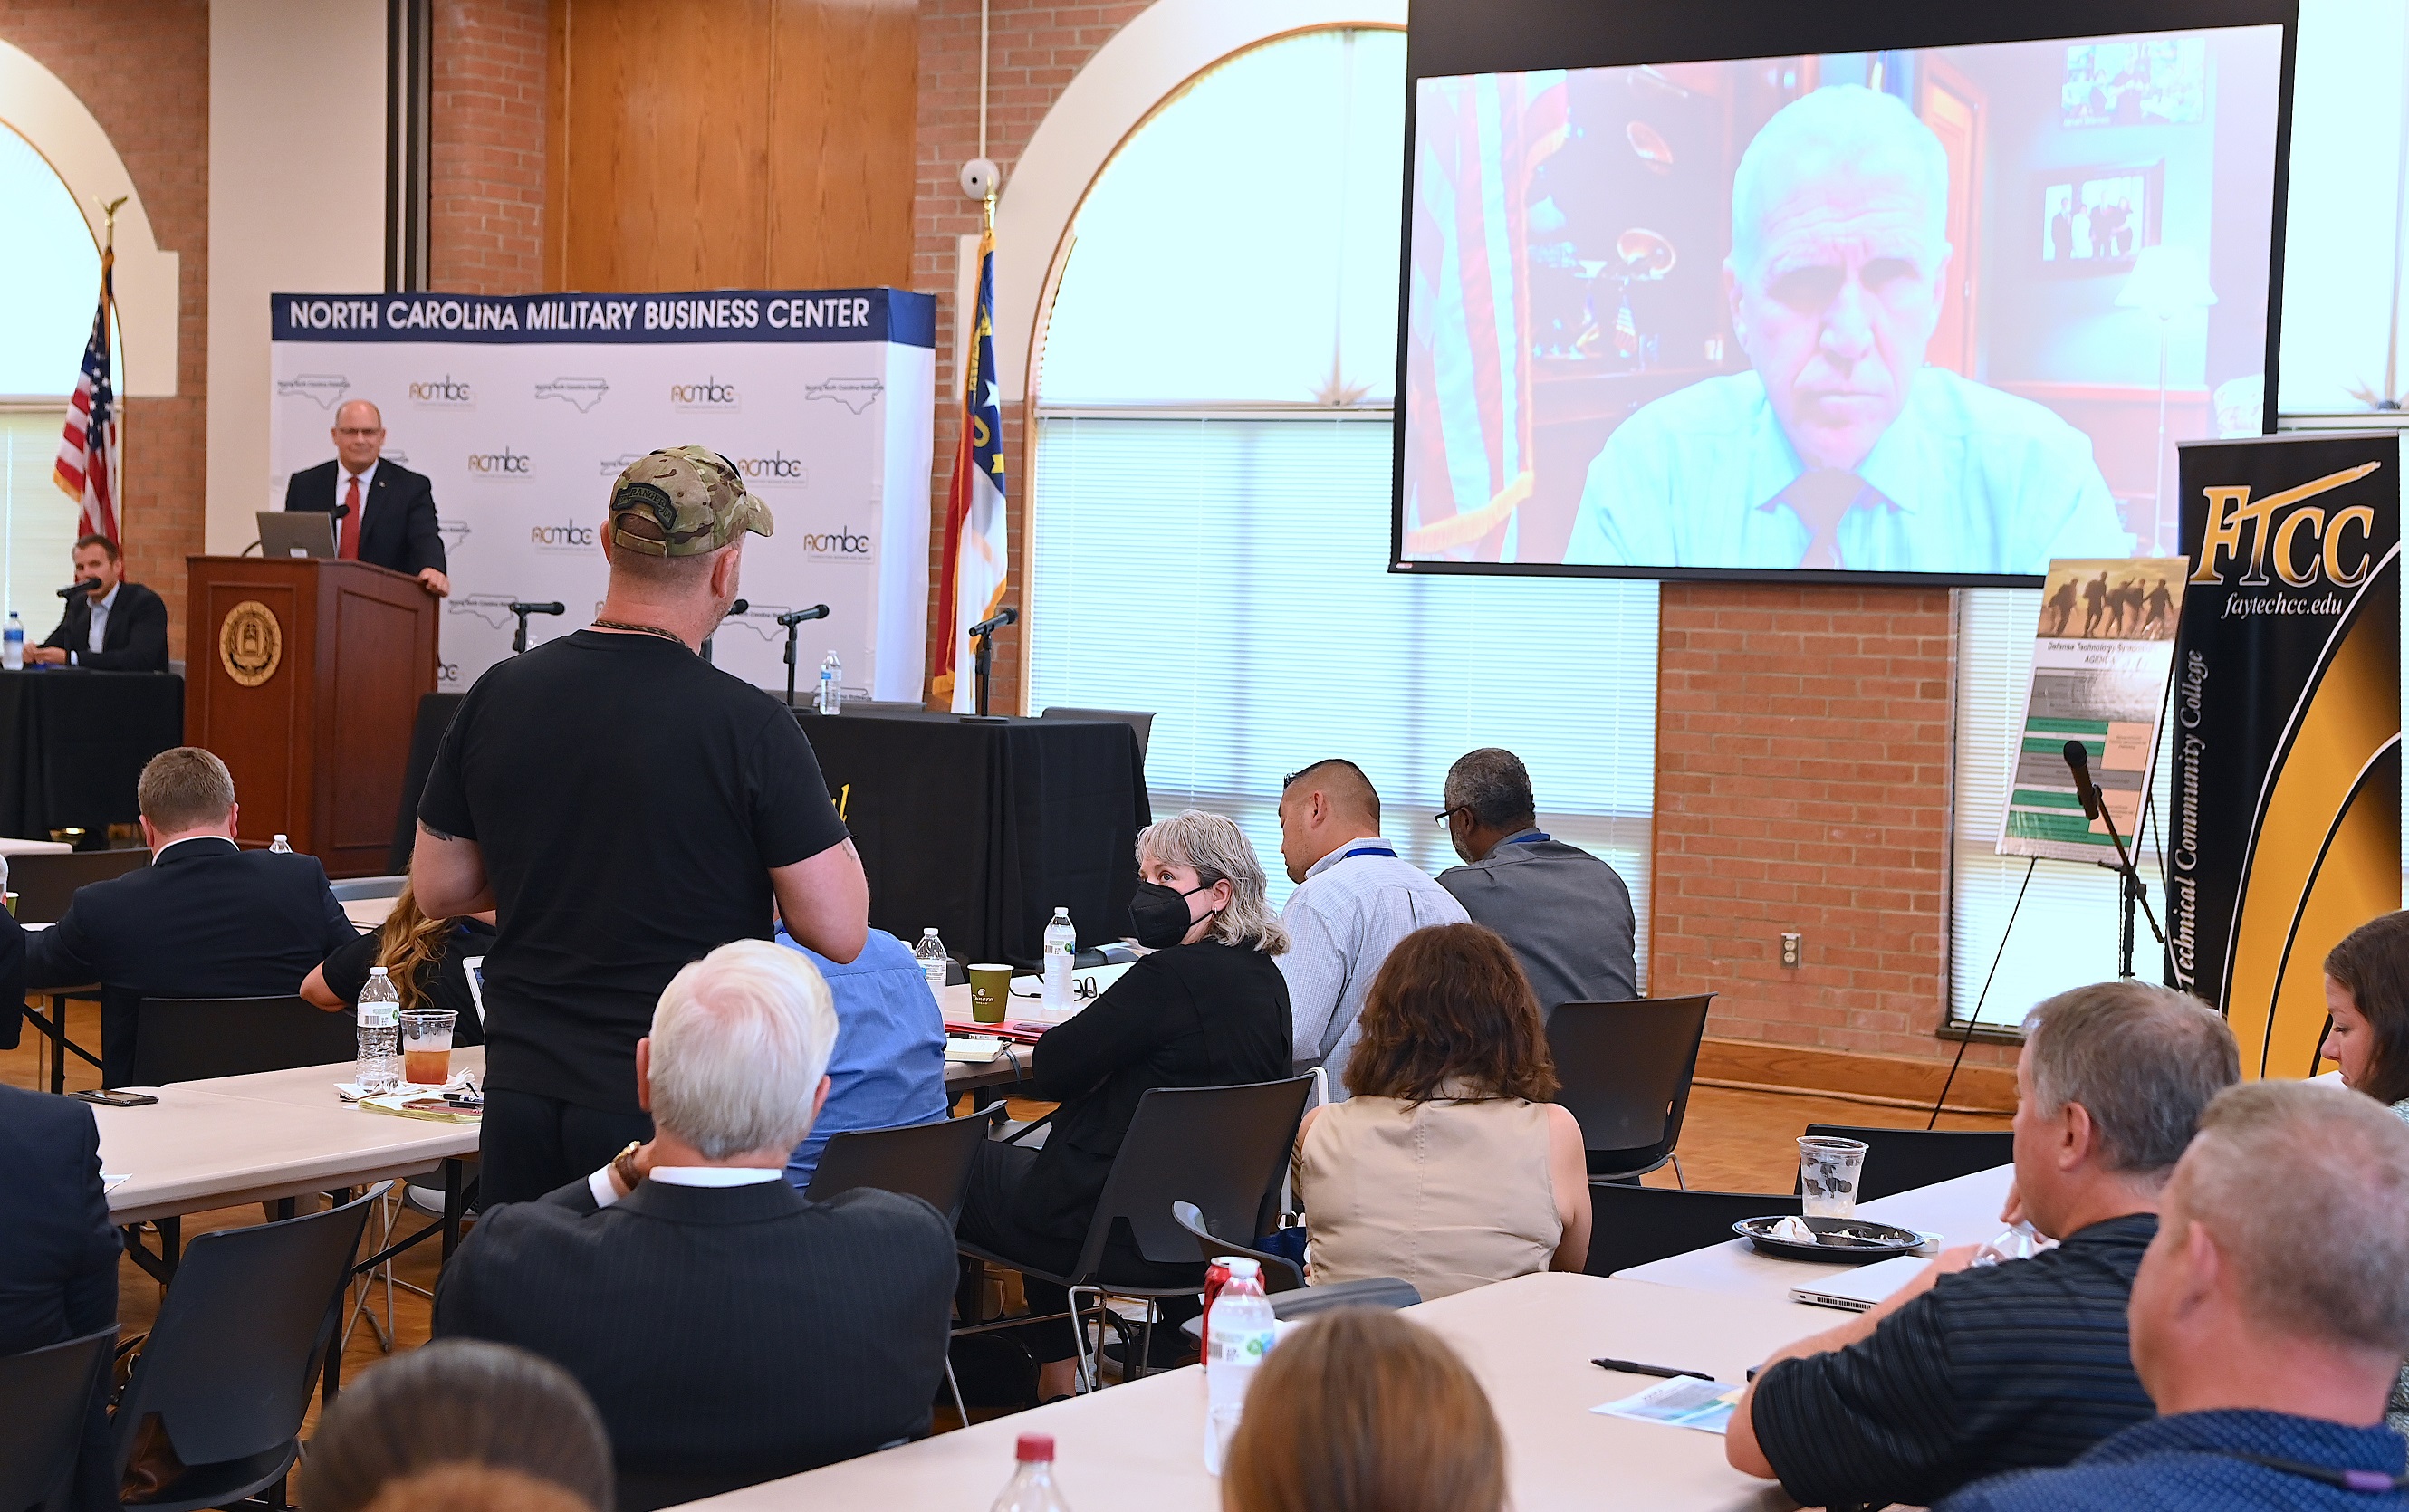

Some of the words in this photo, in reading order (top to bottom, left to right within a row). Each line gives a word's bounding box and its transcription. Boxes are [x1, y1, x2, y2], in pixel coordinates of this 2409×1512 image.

[290, 301, 379, 330] NORTH
[385, 301, 520, 330] CAROLINA
[525, 300, 638, 330] MILITARY
[643, 299, 759, 330] BUSINESS
[766, 297, 870, 329] CENTER
[629, 487, 667, 508] RANGER
[2188, 459, 2382, 589] FTCC
[2220, 591, 2344, 620] faytechcc.edu
[2047, 642, 2075, 651] Defense
[2077, 642, 2115, 653] Technology
[2179, 649, 2209, 729] College
[2174, 732, 2206, 871] Community
[2166, 874, 2196, 989] Technical
